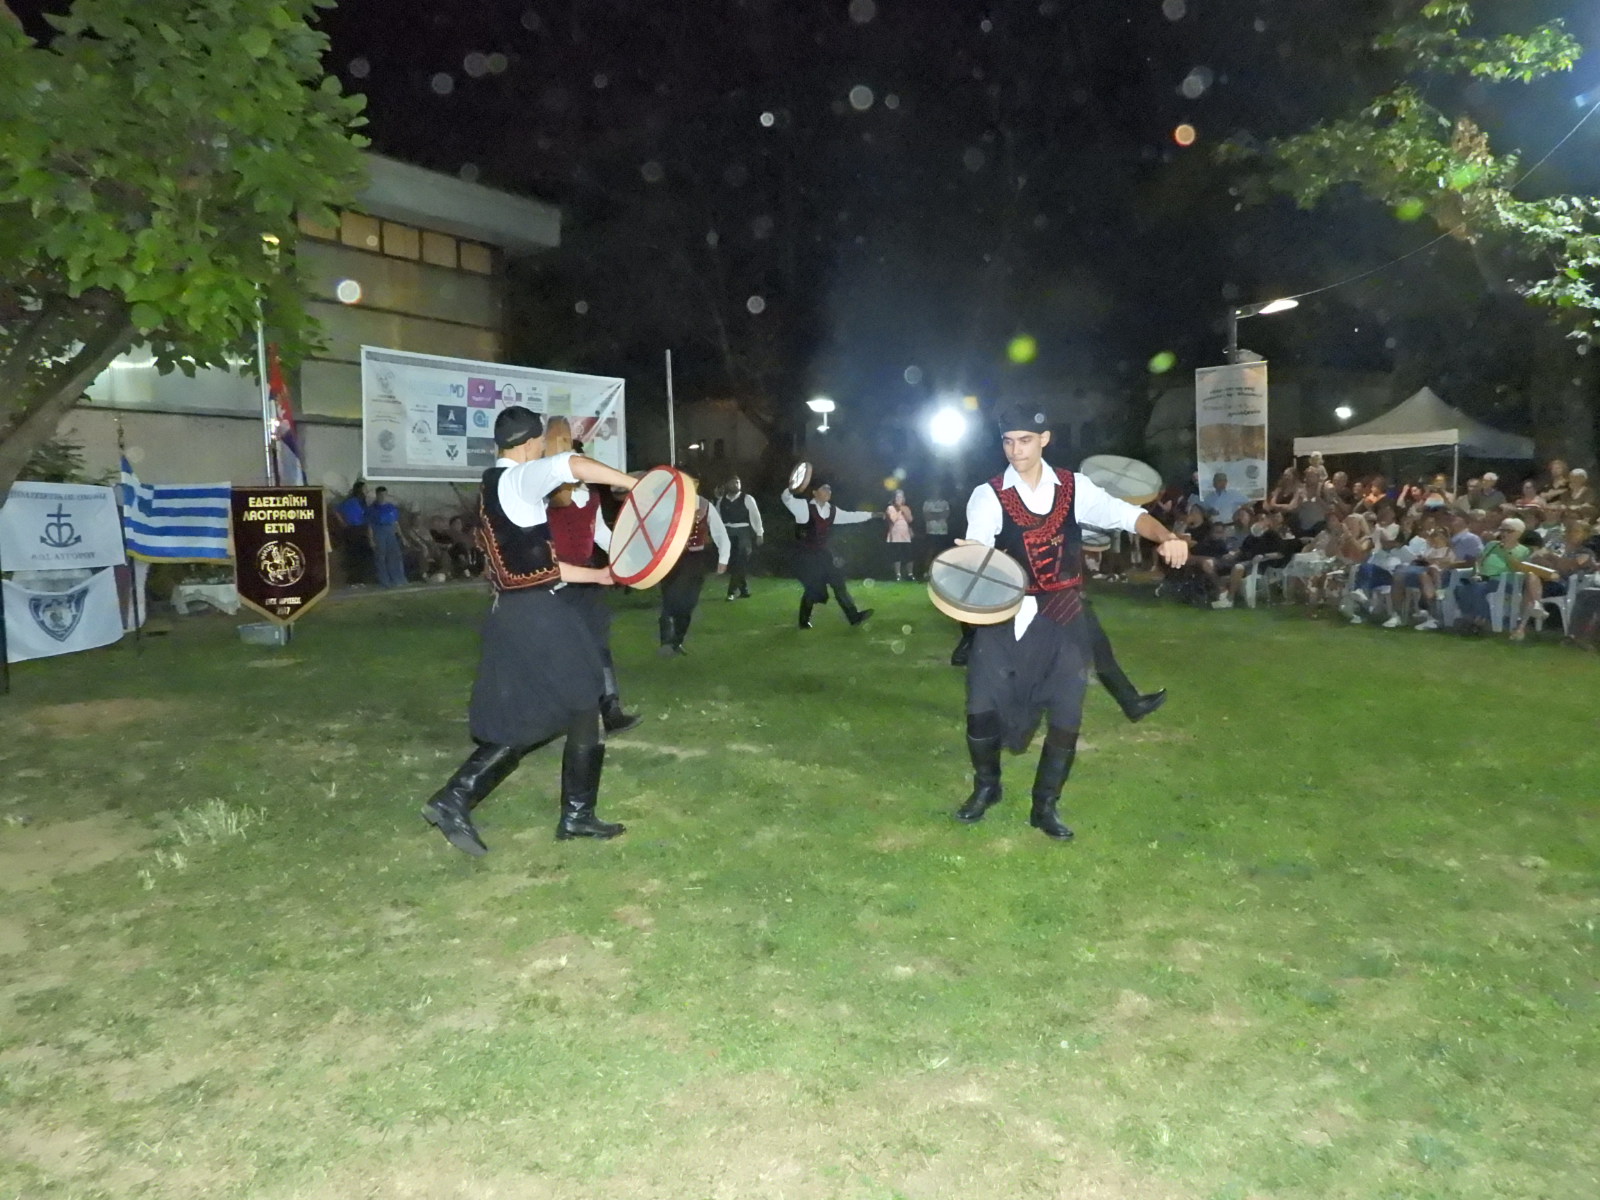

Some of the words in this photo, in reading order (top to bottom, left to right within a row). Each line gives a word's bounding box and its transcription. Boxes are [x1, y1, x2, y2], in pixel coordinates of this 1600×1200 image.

[248, 494, 308, 507] ΕΔΕΣΣΑΪΚΗ
[242, 509, 315, 521] ΛΑΟΓΡΑΦΙΚΗ
[264, 522, 296, 534] ΕΣΤΙΑ
